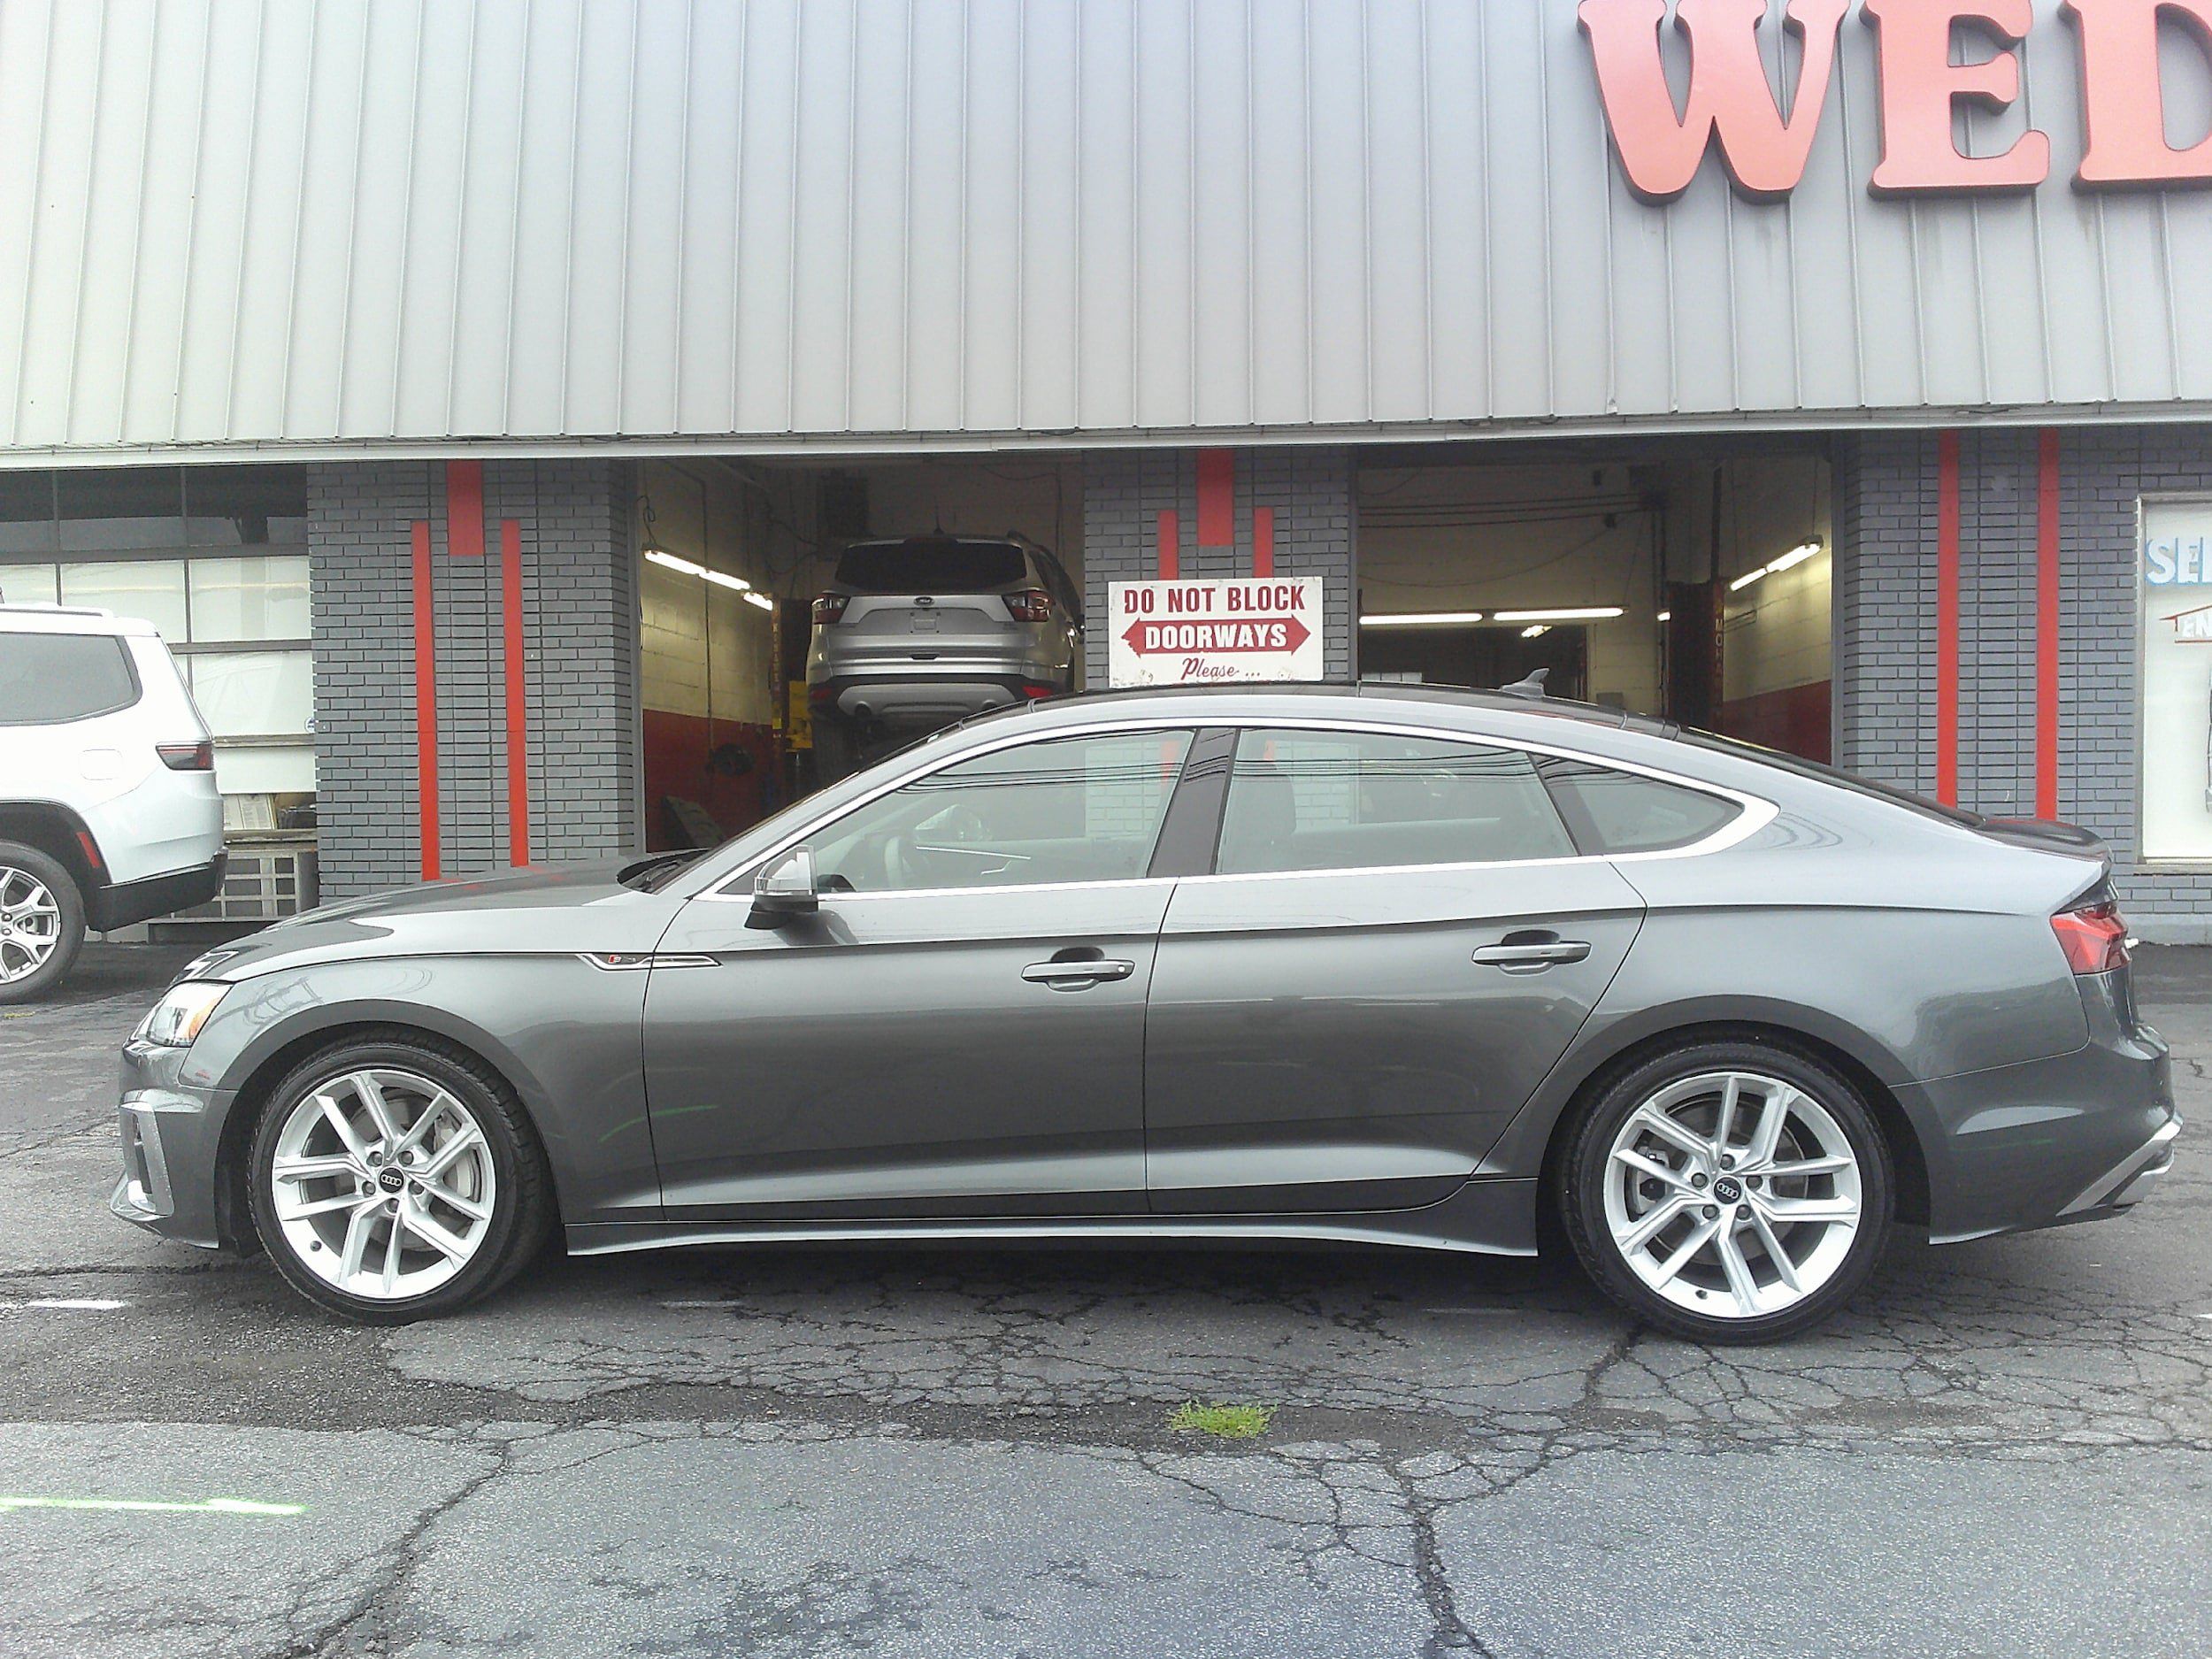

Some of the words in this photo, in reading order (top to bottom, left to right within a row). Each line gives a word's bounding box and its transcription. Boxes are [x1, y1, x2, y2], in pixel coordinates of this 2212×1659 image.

[2145, 537, 2212, 586] SE
[1124, 588, 1155, 614] DO
[1168, 588, 1216, 613] NOT
[1227, 585, 1306, 611] BLOCK
[1145, 623, 1287, 650] DOORWAYS
